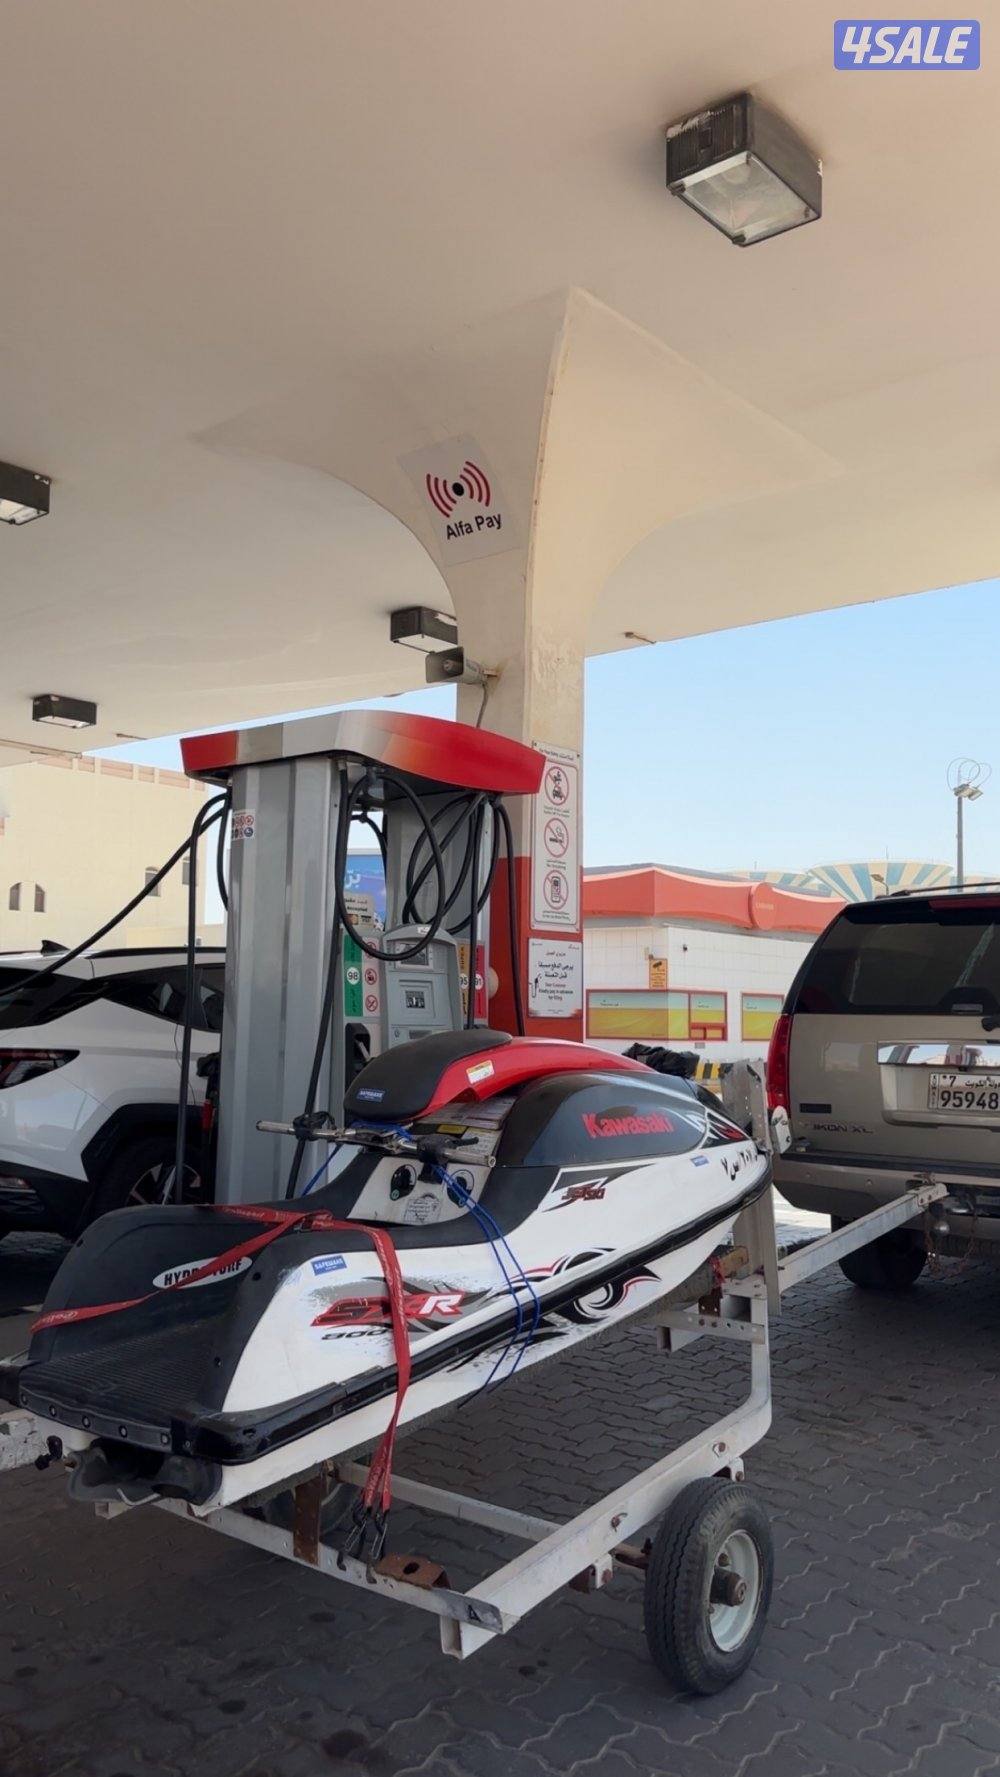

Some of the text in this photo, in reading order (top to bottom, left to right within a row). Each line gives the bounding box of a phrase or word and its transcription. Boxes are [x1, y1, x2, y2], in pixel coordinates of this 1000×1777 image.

[447, 514, 502, 540] Alfa Pay
[347, 971, 359, 981] 98
[949, 1075, 957, 1087] 7
[941, 1090, 999, 1110] 95948
[582, 1111, 675, 1139] Kawasaki
